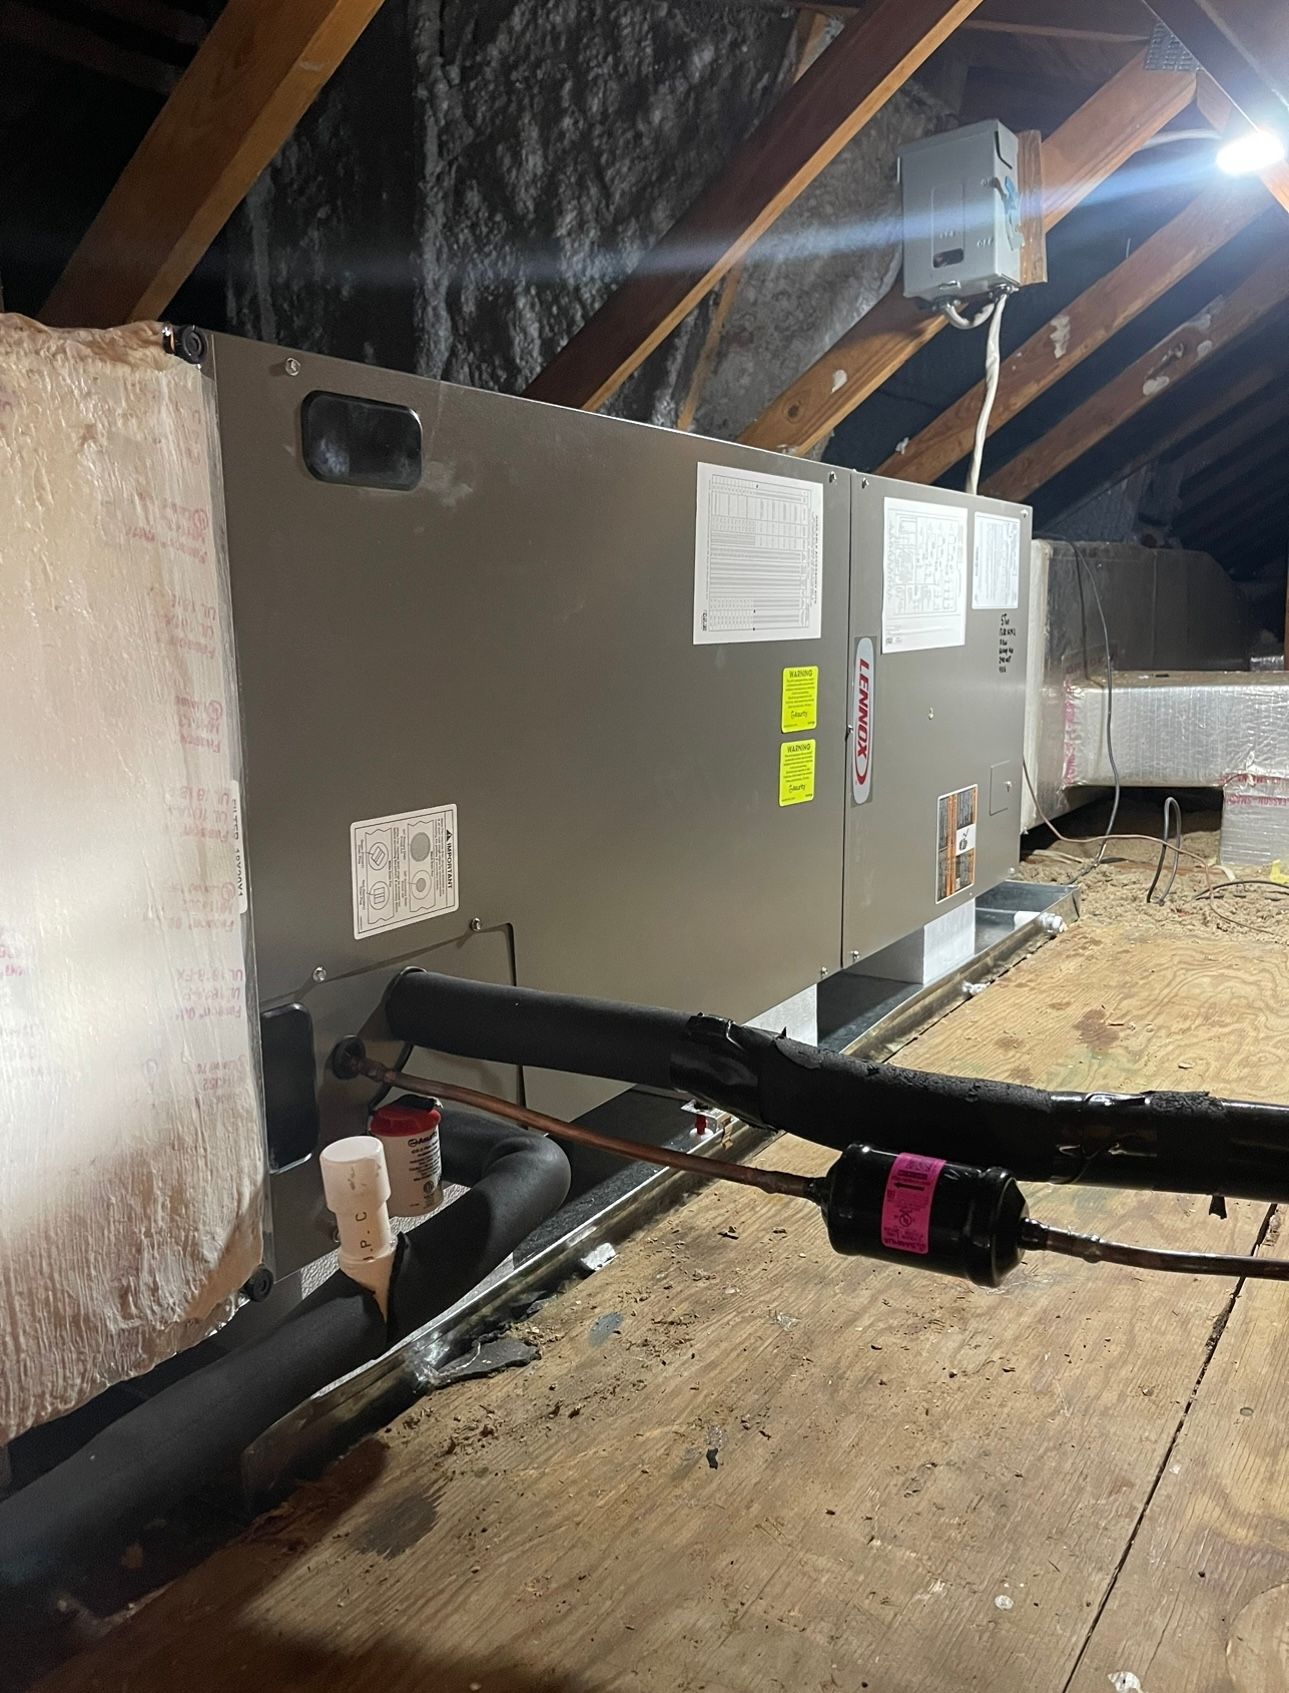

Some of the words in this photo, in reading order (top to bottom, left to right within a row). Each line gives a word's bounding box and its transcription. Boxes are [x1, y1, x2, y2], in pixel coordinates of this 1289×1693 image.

[789, 669, 813, 678] WARNING
[858, 658, 870, 759] LENNOX
[787, 743, 811, 753] WARNING
